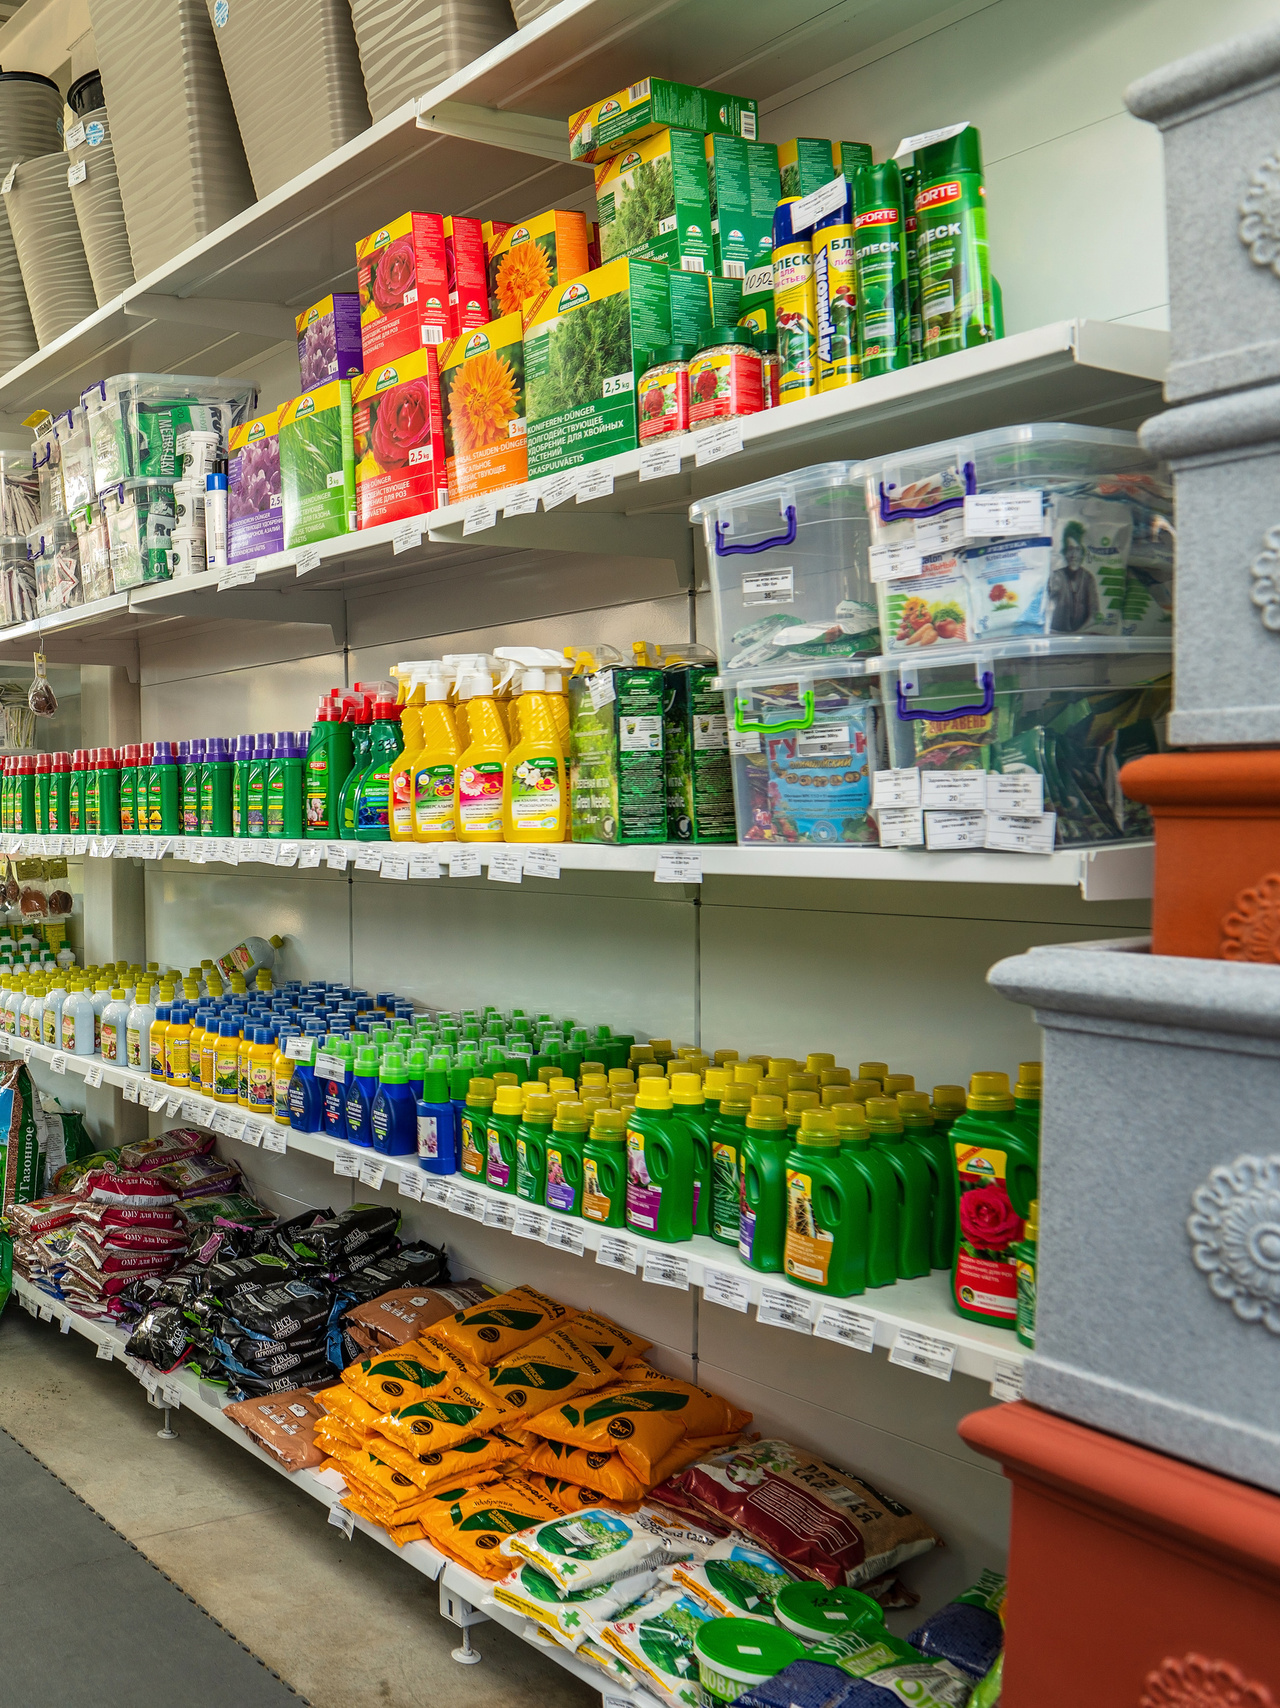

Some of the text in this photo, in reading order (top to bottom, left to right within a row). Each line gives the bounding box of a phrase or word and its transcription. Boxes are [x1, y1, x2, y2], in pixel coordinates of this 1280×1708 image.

[860, 210, 897, 224] FORTE
[856, 241, 900, 261] БЛЕСК
[772, 253, 812, 275] БЛЕСК
[780, 266, 796, 277] ДЛЯ
[559, 295, 590, 312] GREENWORLD
[604, 378, 630, 394] 2,5 kg
[527, 404, 596, 434] KONIFEREN-DÜNGER
[527, 415, 604, 448] ДОЛГОДЕЙСТВУЮЩЕЕ
[528, 419, 624, 456] УДОБРЕНИЕ ДЛЯ ХВОЙНЫХ
[158, 419, 175, 476] МЕДВЕДКИ
[472, 438, 528, 460] STAUDEN-DÜNGER
[527, 446, 563, 465] РАСТЕНИЙ
[410, 451, 423, 463] 2,5
[527, 453, 585, 477] OKASPUUVÄETIS
[270, 494, 282, 507] 2,5
[395, 490, 407, 501] РОЗ
[153, 562, 166, 573] ОТ
[789, 756, 852, 770] ОЛИМПИЙСКИЙ
[20, 1126, 35, 1192] Газонное
[145, 1157, 160, 1166] ОМУ
[172, 1149, 196, 1161] Цветов
[139, 1176, 153, 1187] Роз
[121, 1209, 164, 1220] ОМУ для Роз
[37, 1220, 52, 1230] ОМУ
[125, 1233, 169, 1245] ОМУ для Роз
[345, 1232, 368, 1252] АГРОУСПЕХ
[350, 1228, 363, 1242] ВСЕХ
[121, 1255, 163, 1267] ОМУ для Роз
[123, 1276, 139, 1286] ОМУ
[272, 1320, 301, 1340] АГРОУСПЕХ
[277, 1315, 293, 1331] ВСЕХ
[272, 1356, 300, 1374] АГРОУСПЕХ
[274, 1376, 291, 1392] ВСЕХ
[609, 1420, 631, 1435] 3кг
[511, 1478, 547, 1503] СУЛЬФАТ
